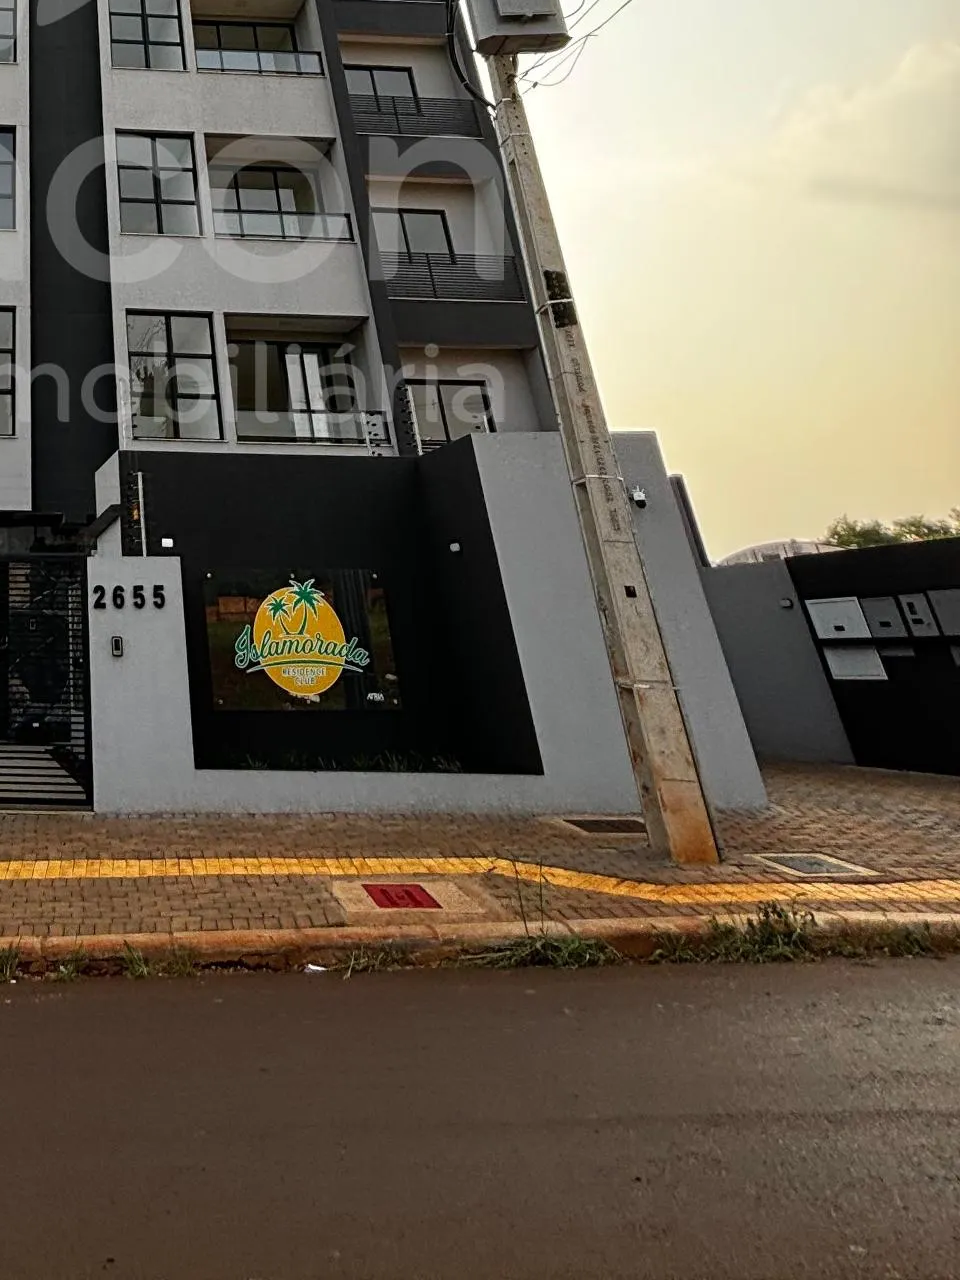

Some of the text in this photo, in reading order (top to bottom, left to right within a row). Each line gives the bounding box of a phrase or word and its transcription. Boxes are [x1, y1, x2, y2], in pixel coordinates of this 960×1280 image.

[93, 584, 166, 609] 2655
[234, 625, 370, 668] Islamorada
[282, 667, 327, 676] RESIDENCE
